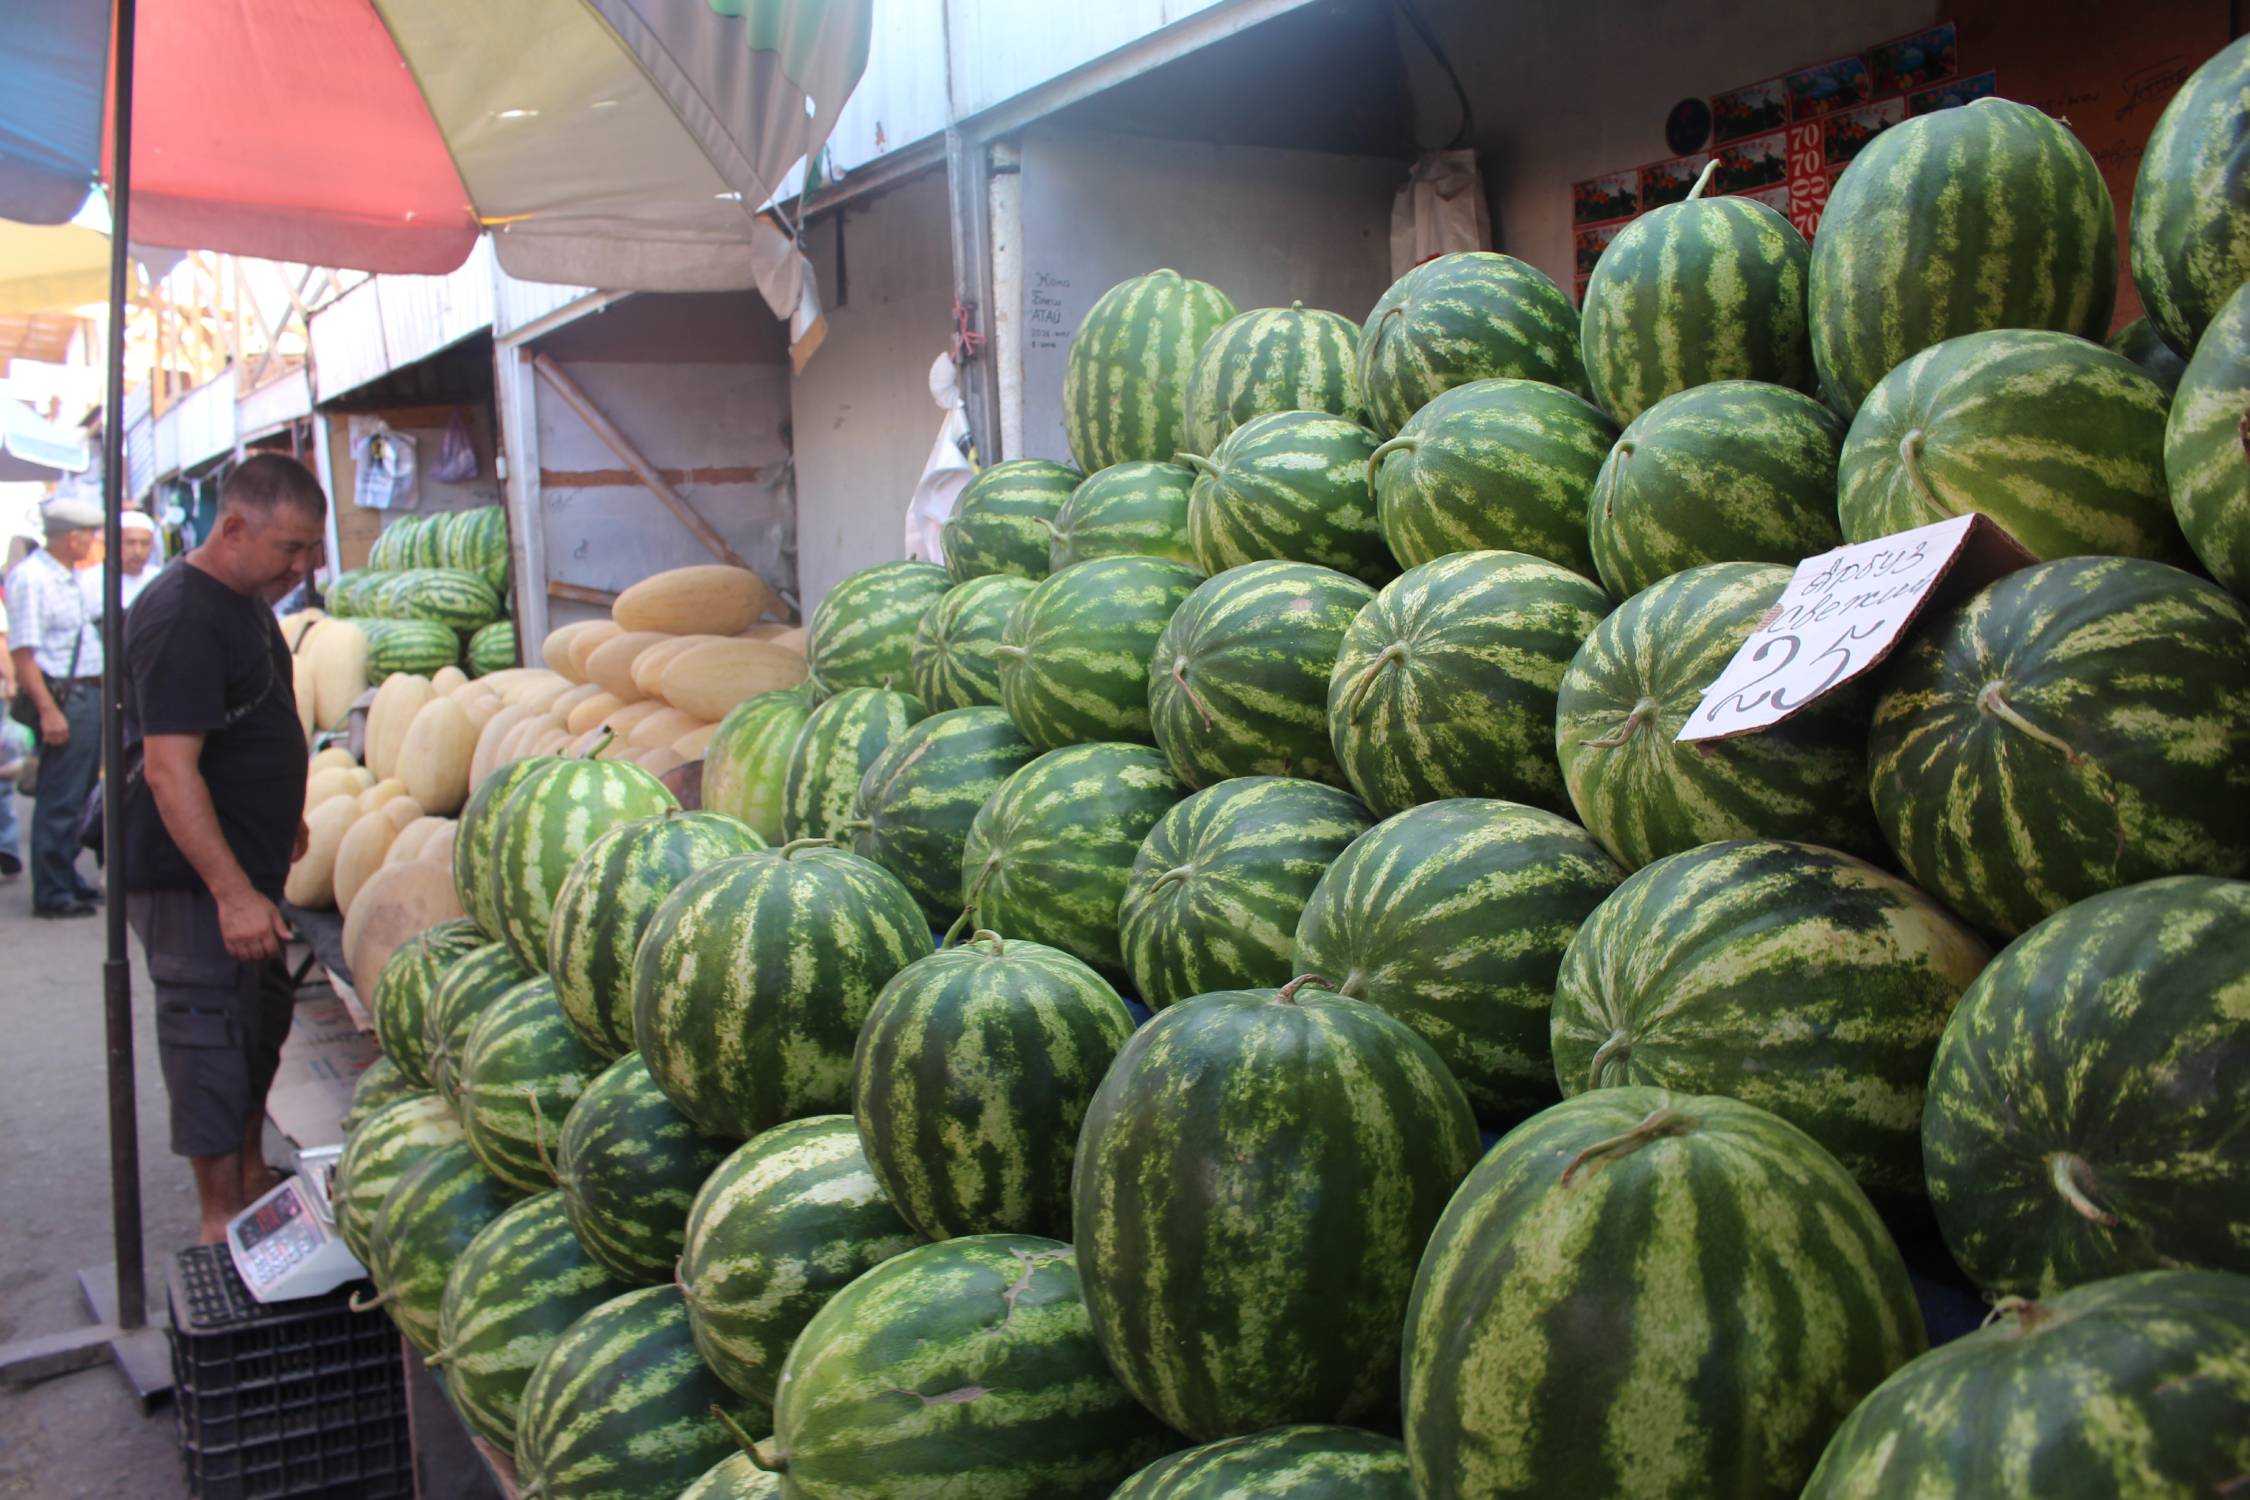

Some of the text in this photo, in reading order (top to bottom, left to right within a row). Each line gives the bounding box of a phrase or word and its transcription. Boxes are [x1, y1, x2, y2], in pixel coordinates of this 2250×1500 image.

[1791, 123, 1819, 151] 70
[1791, 150, 1820, 176] 70
[1791, 178, 1811, 213] 70
[1800, 540, 1928, 597] Арбуз
[1706, 619, 1886, 722] 25
